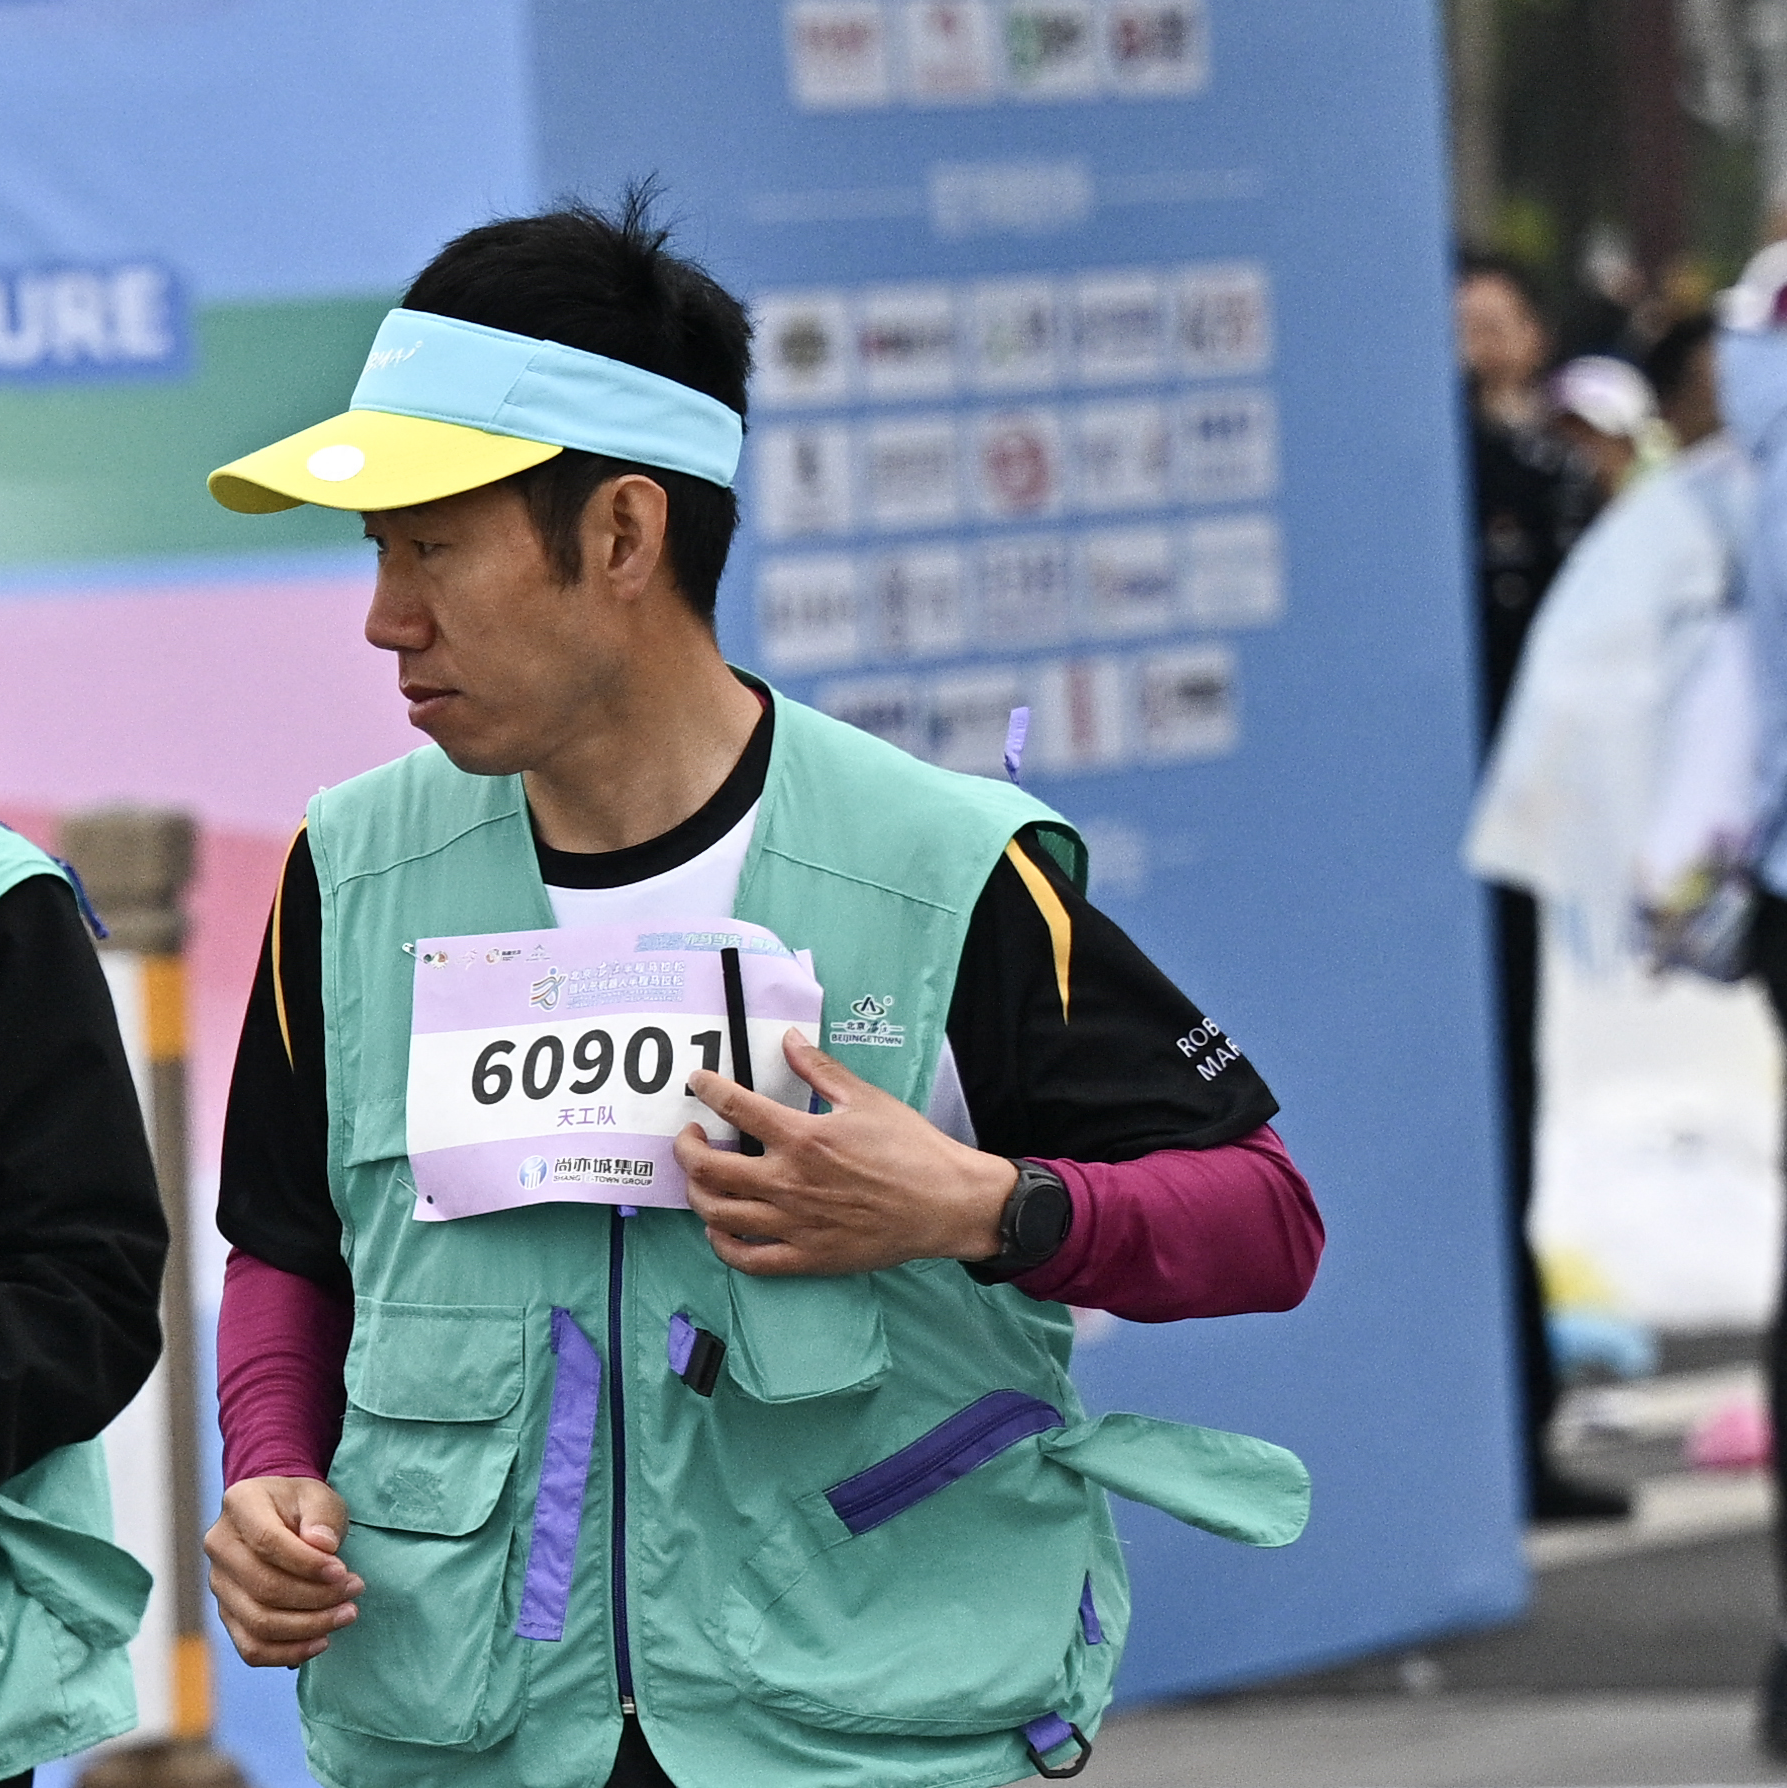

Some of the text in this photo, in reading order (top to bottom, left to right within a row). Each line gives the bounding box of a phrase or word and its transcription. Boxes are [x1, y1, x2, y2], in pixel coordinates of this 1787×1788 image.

[831, 1033, 903, 1045] BEIJINGETOWN
[1176, 1016, 1220, 1058] ROB
[472, 1026, 722, 1105] 60901
[1196, 1037, 1242, 1082] MAR
[556, 1105, 617, 1126] 天工队
[554, 1158, 653, 1178] 尚亦城集团
